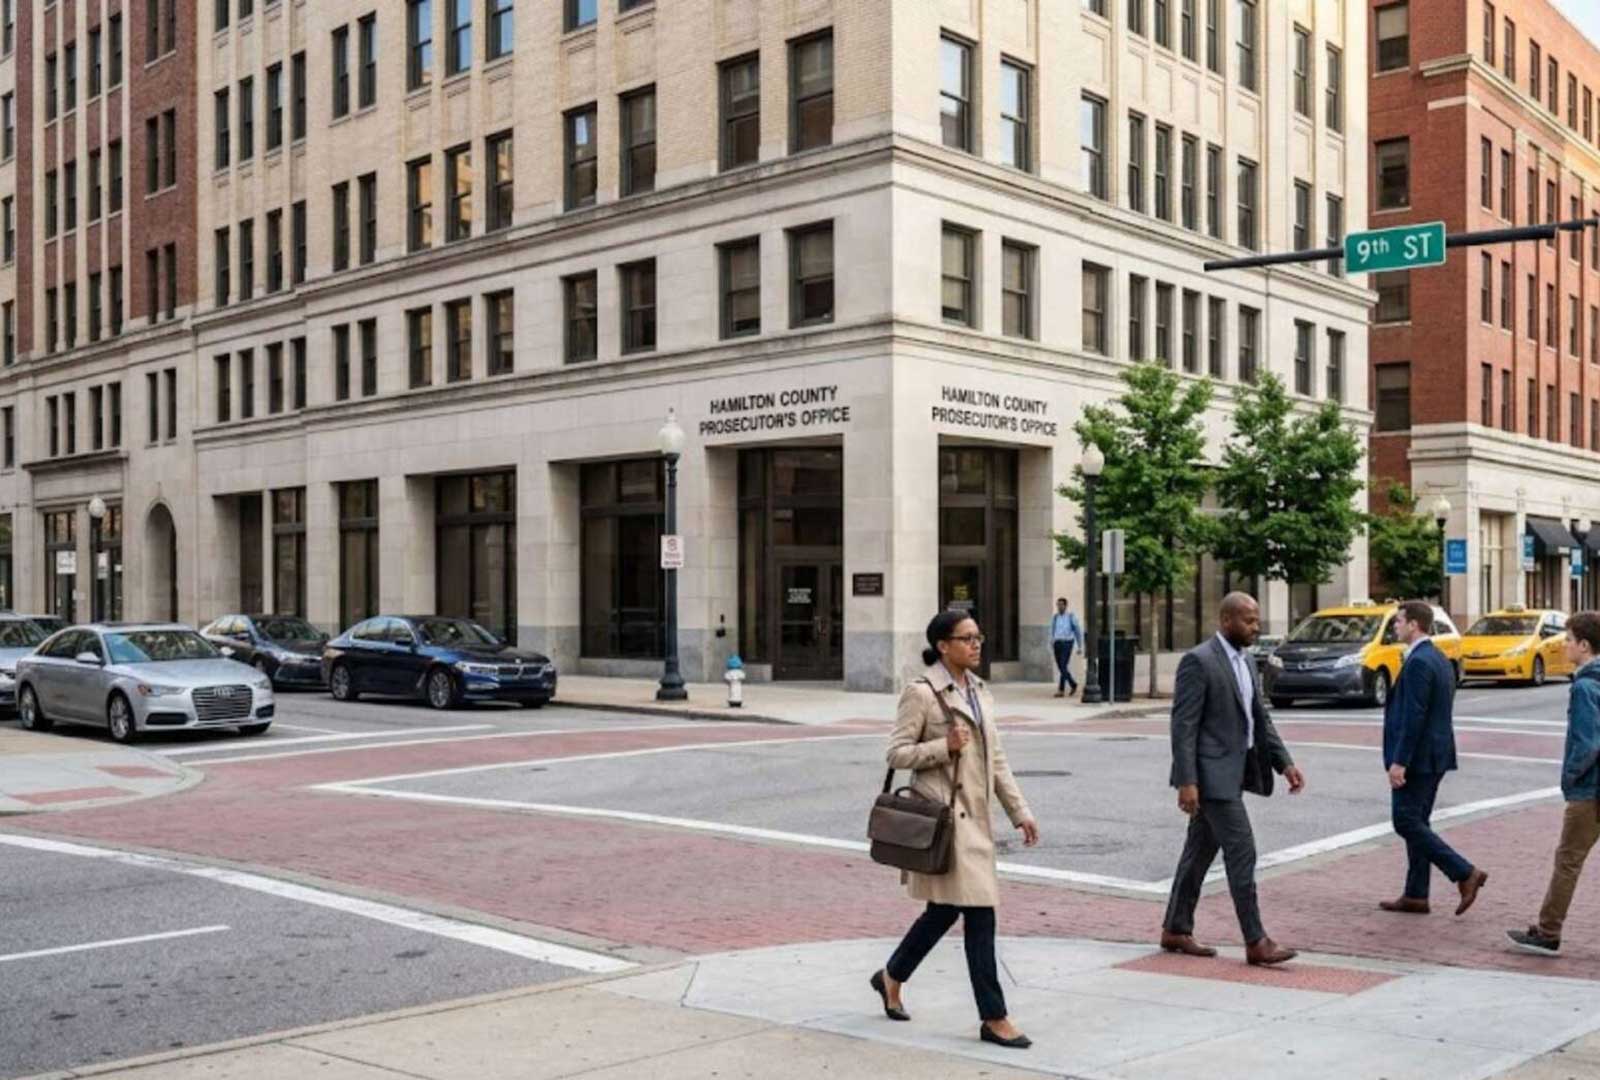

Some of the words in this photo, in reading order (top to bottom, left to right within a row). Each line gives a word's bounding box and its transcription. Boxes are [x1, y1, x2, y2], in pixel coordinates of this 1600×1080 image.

[1357, 238, 1390, 264] 9th
[1403, 232, 1432, 260] ST
[710, 393, 775, 414] HAMILTON
[780, 385, 838, 407] COUNTY
[942, 386, 1000, 408] HAMILTON
[1004, 395, 1048, 415] COUNTY
[699, 412, 797, 436] PROSECUTOR'S
[932, 406, 1018, 432] PROSECUTOR'S
